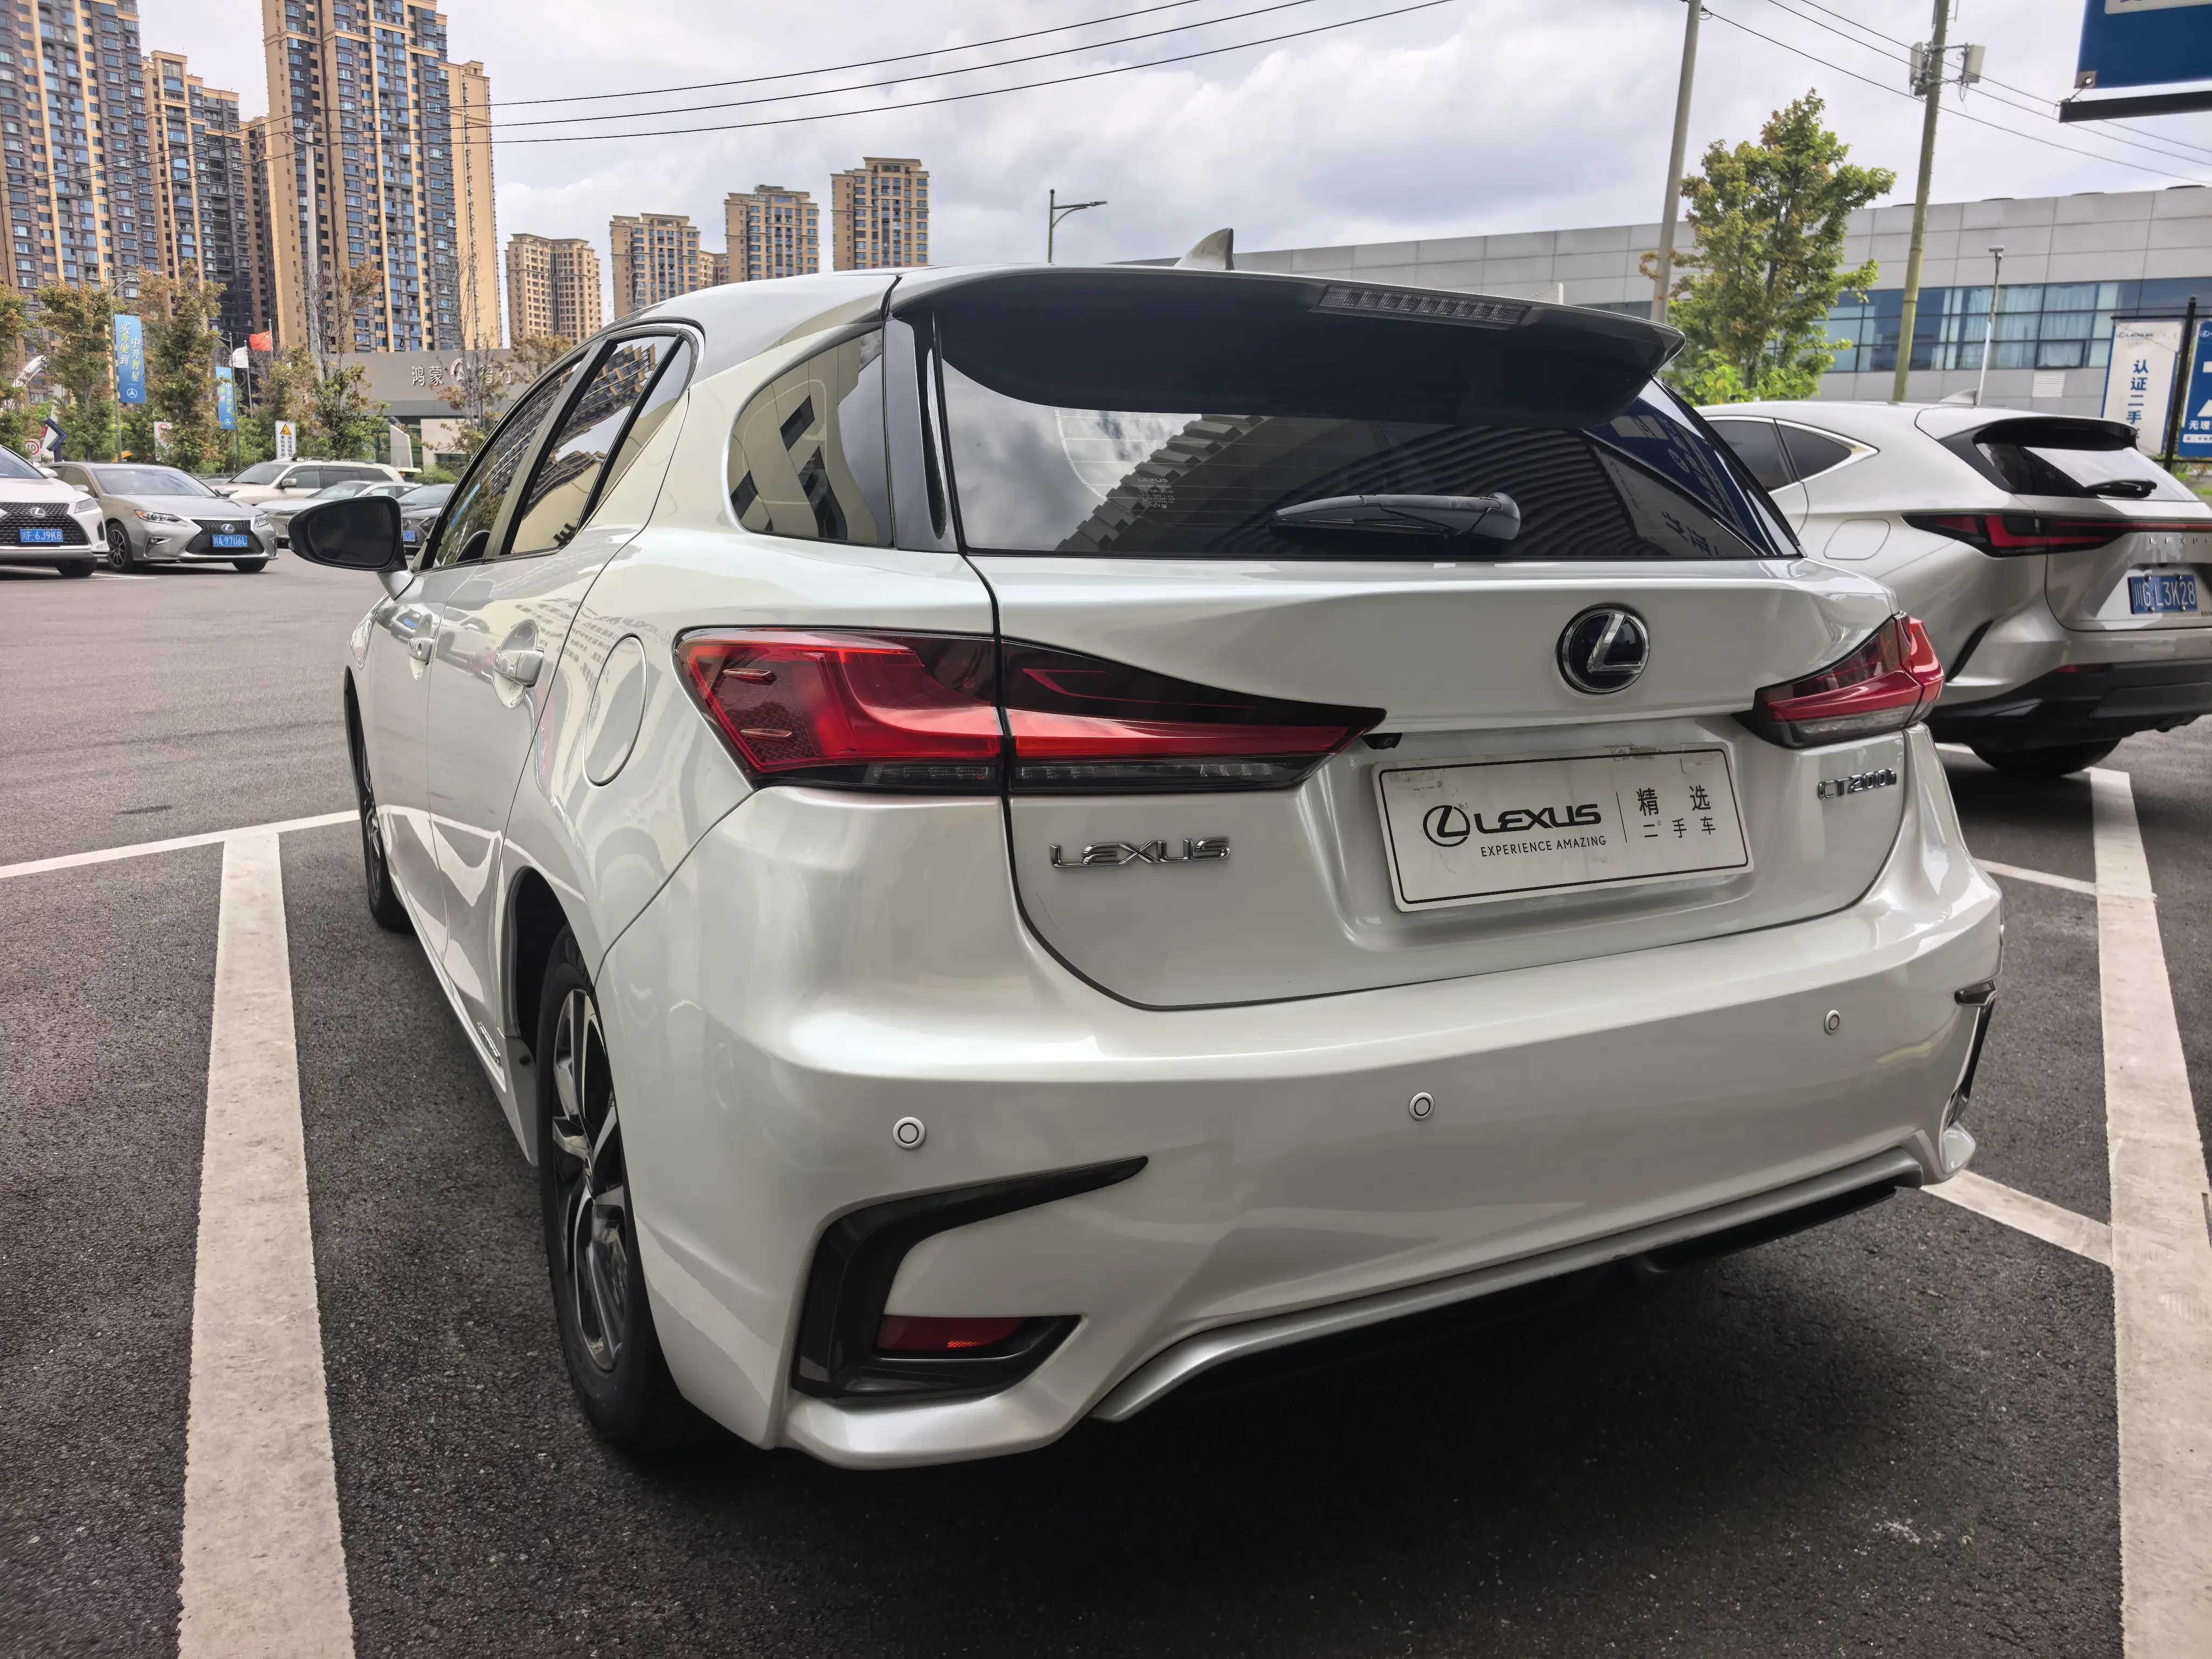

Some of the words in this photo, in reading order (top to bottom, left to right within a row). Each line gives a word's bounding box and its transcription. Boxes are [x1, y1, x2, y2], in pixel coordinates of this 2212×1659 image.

[119, 322, 131, 366] 买奔驰到
[412, 365, 443, 387] 鸿蒙
[1473, 804, 1602, 834] LEXUS
[1643, 816, 1716, 838] 二手车
[1050, 836, 1232, 868] LEXUS
[1480, 840, 1553, 858] EXPERIENCE
[1556, 835, 1607, 850] AMAZING
